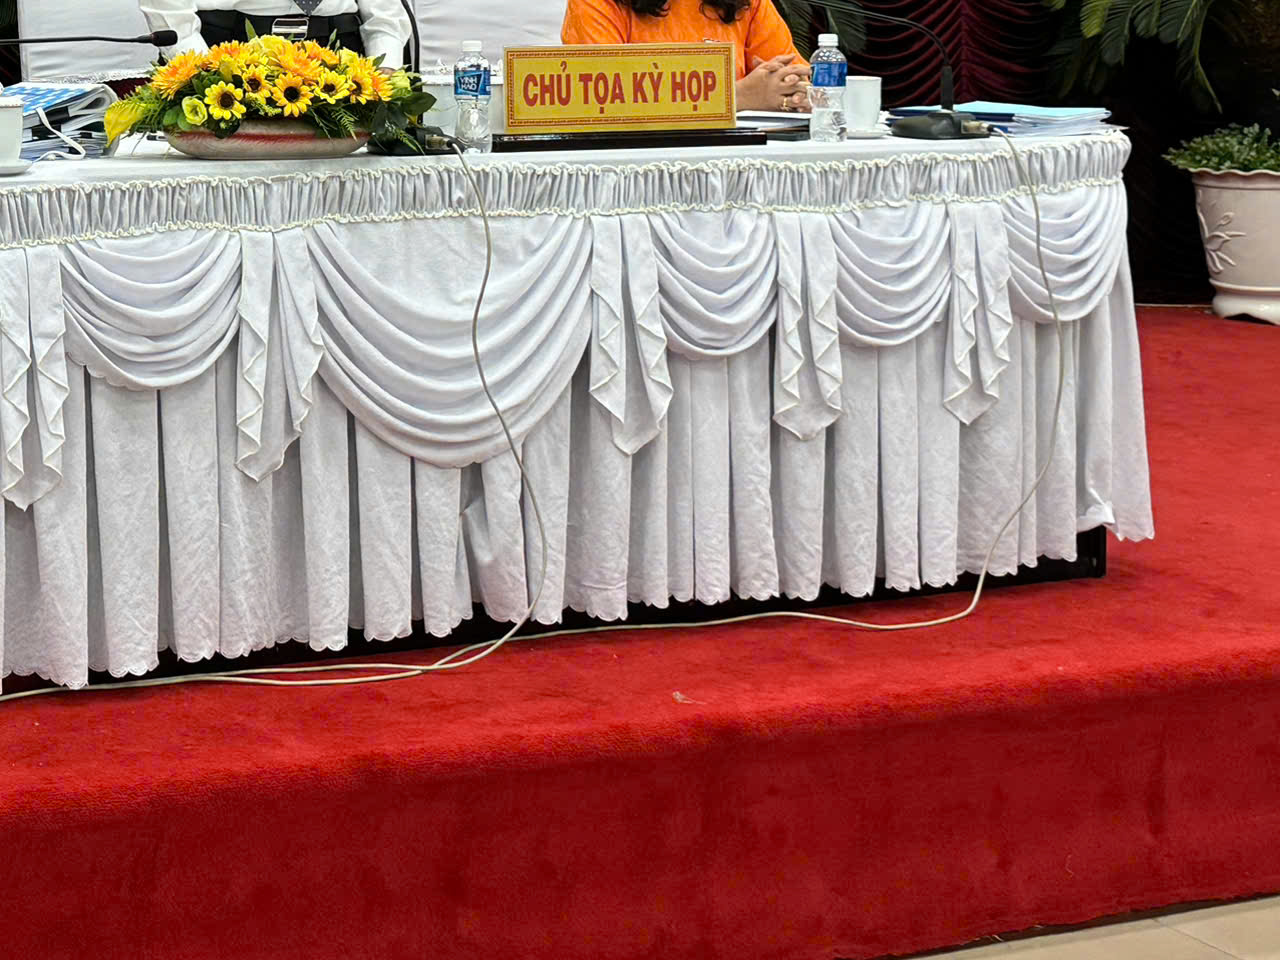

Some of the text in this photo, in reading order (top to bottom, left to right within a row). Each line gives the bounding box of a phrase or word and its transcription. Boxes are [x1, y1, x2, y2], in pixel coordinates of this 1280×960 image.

[522, 60, 717, 115] CHỦ TỌA KỲ HỌP
